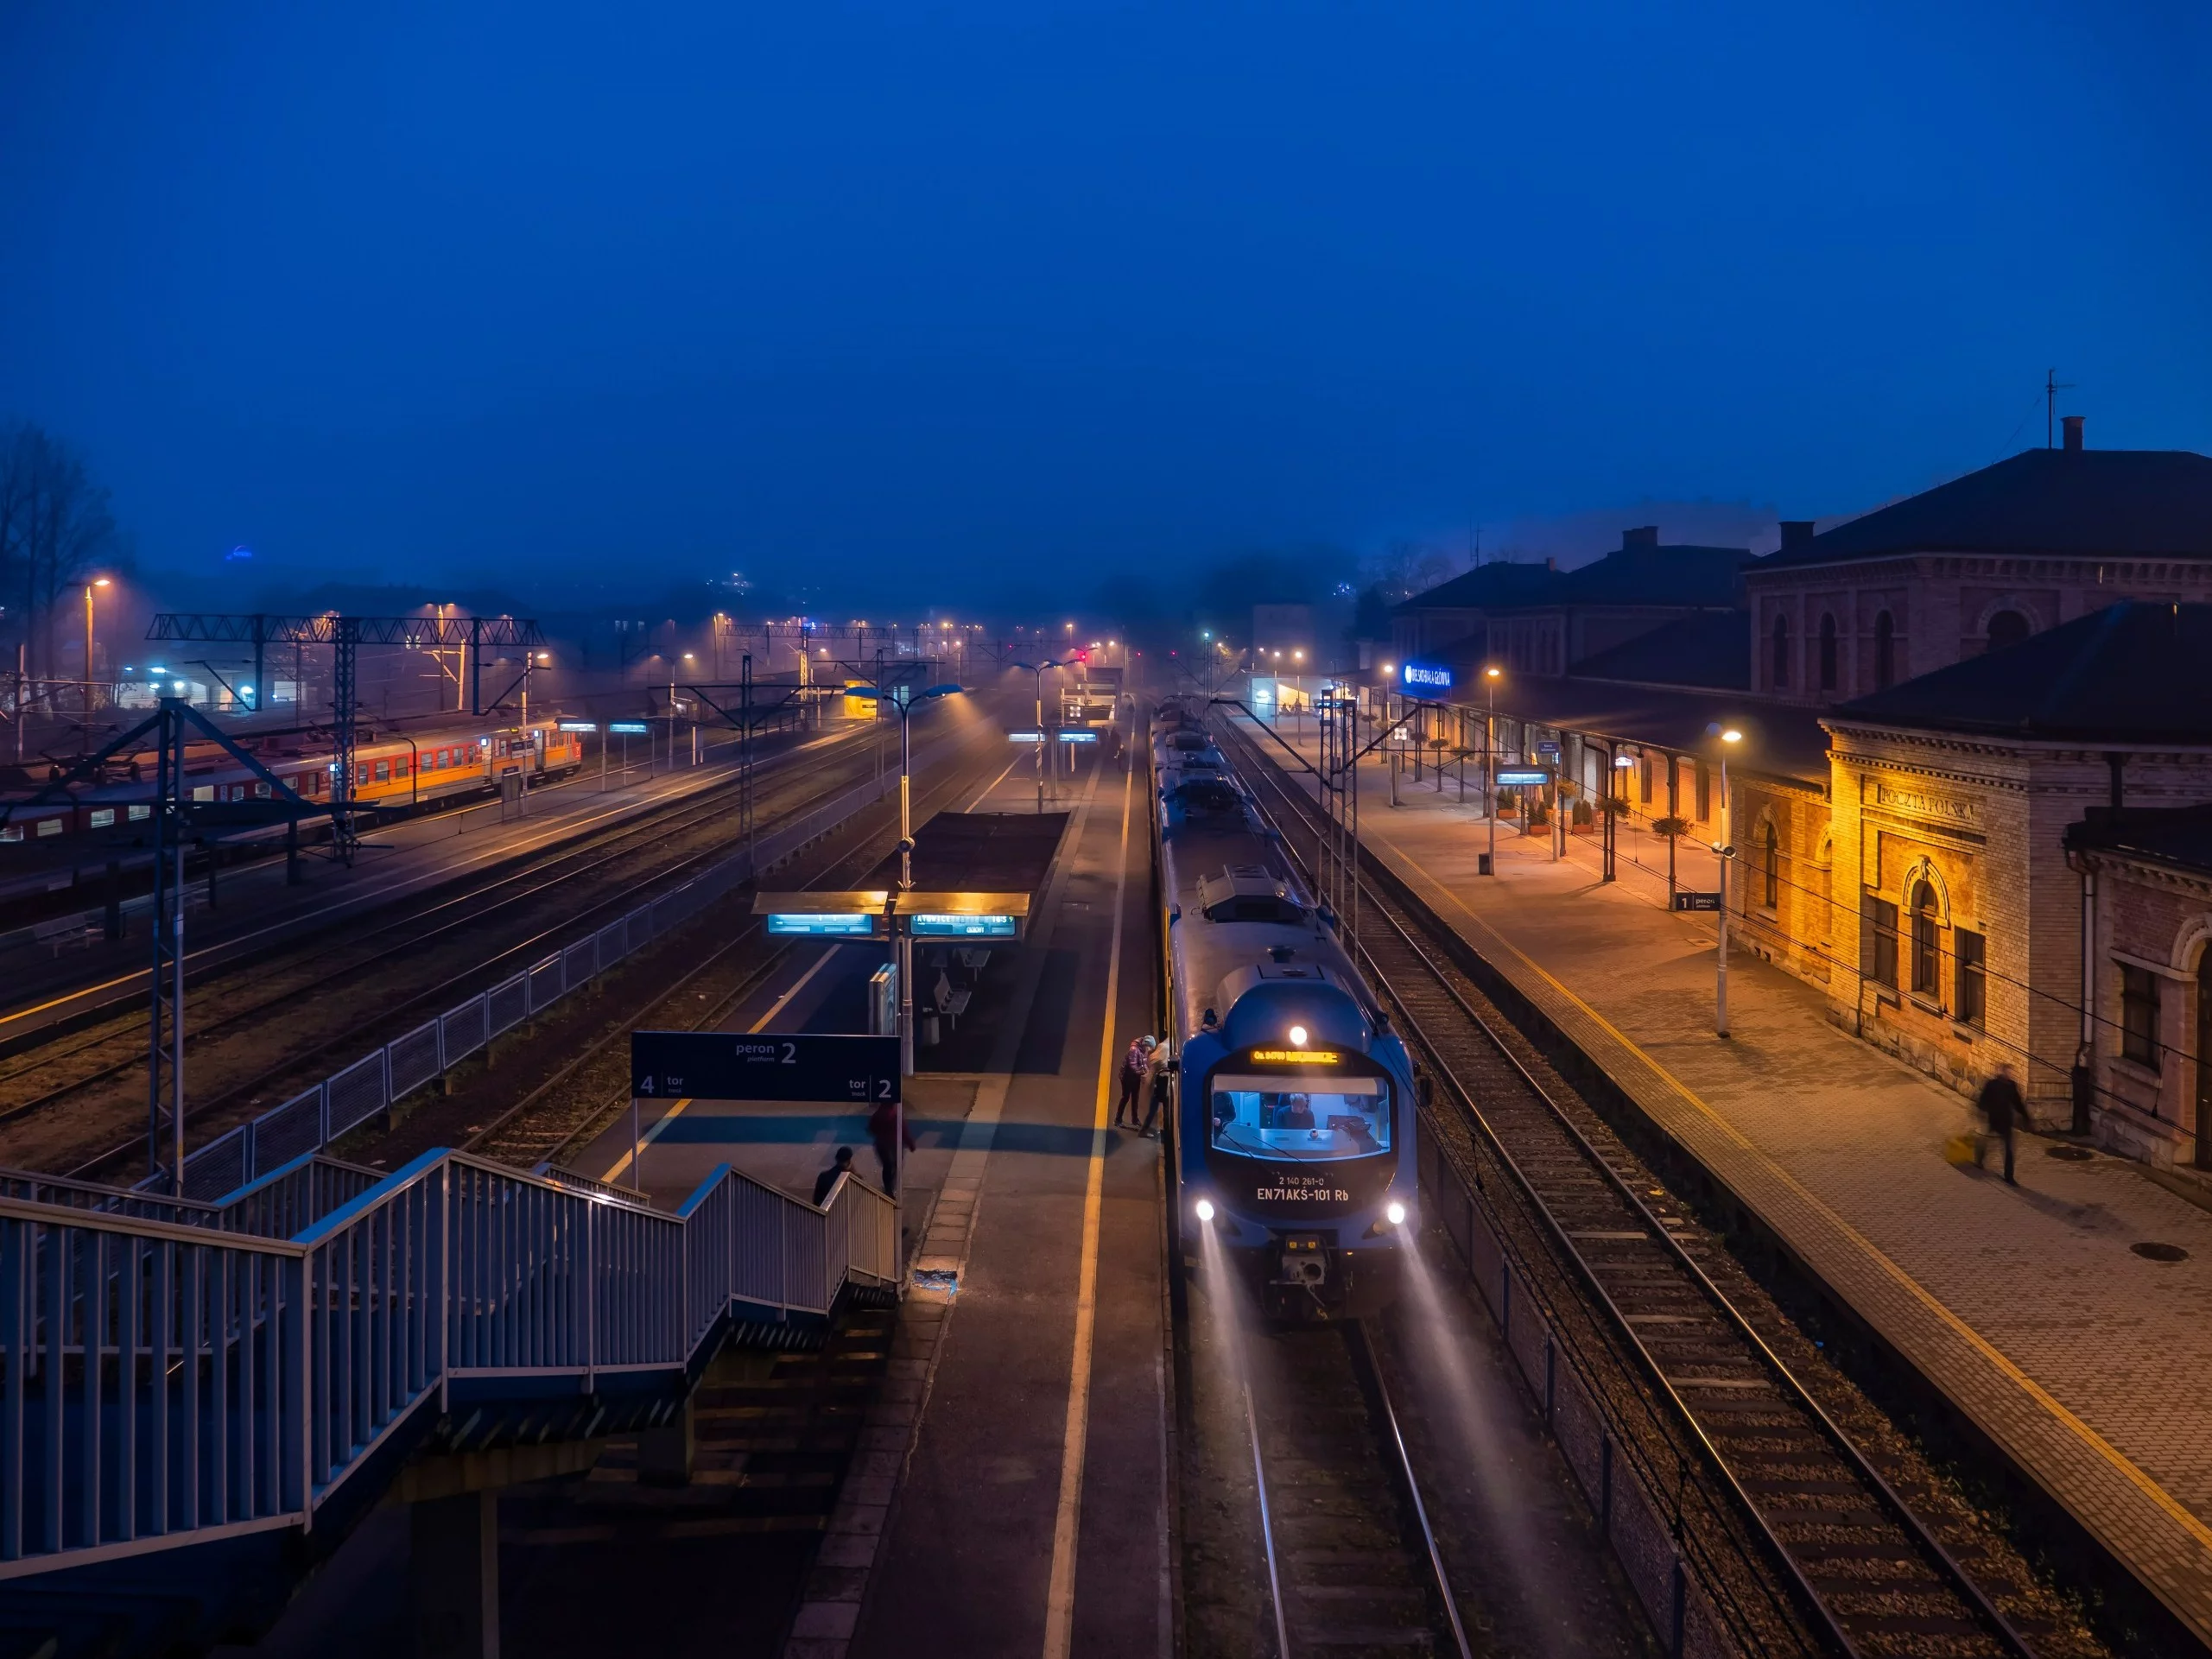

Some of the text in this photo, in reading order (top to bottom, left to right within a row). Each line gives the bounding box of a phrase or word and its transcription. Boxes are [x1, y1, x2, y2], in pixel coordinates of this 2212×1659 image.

[1881, 787, 1974, 820] POCZTA POLSKA
[1682, 897, 1687, 909] 1
[736, 1042, 796, 1064] peron 2
[640, 1075, 683, 1093] 4 tor
[849, 1079, 891, 1099] tor 2
[1279, 1176, 1284, 1185] 2
[1334, 1189, 1349, 1201] Rb
